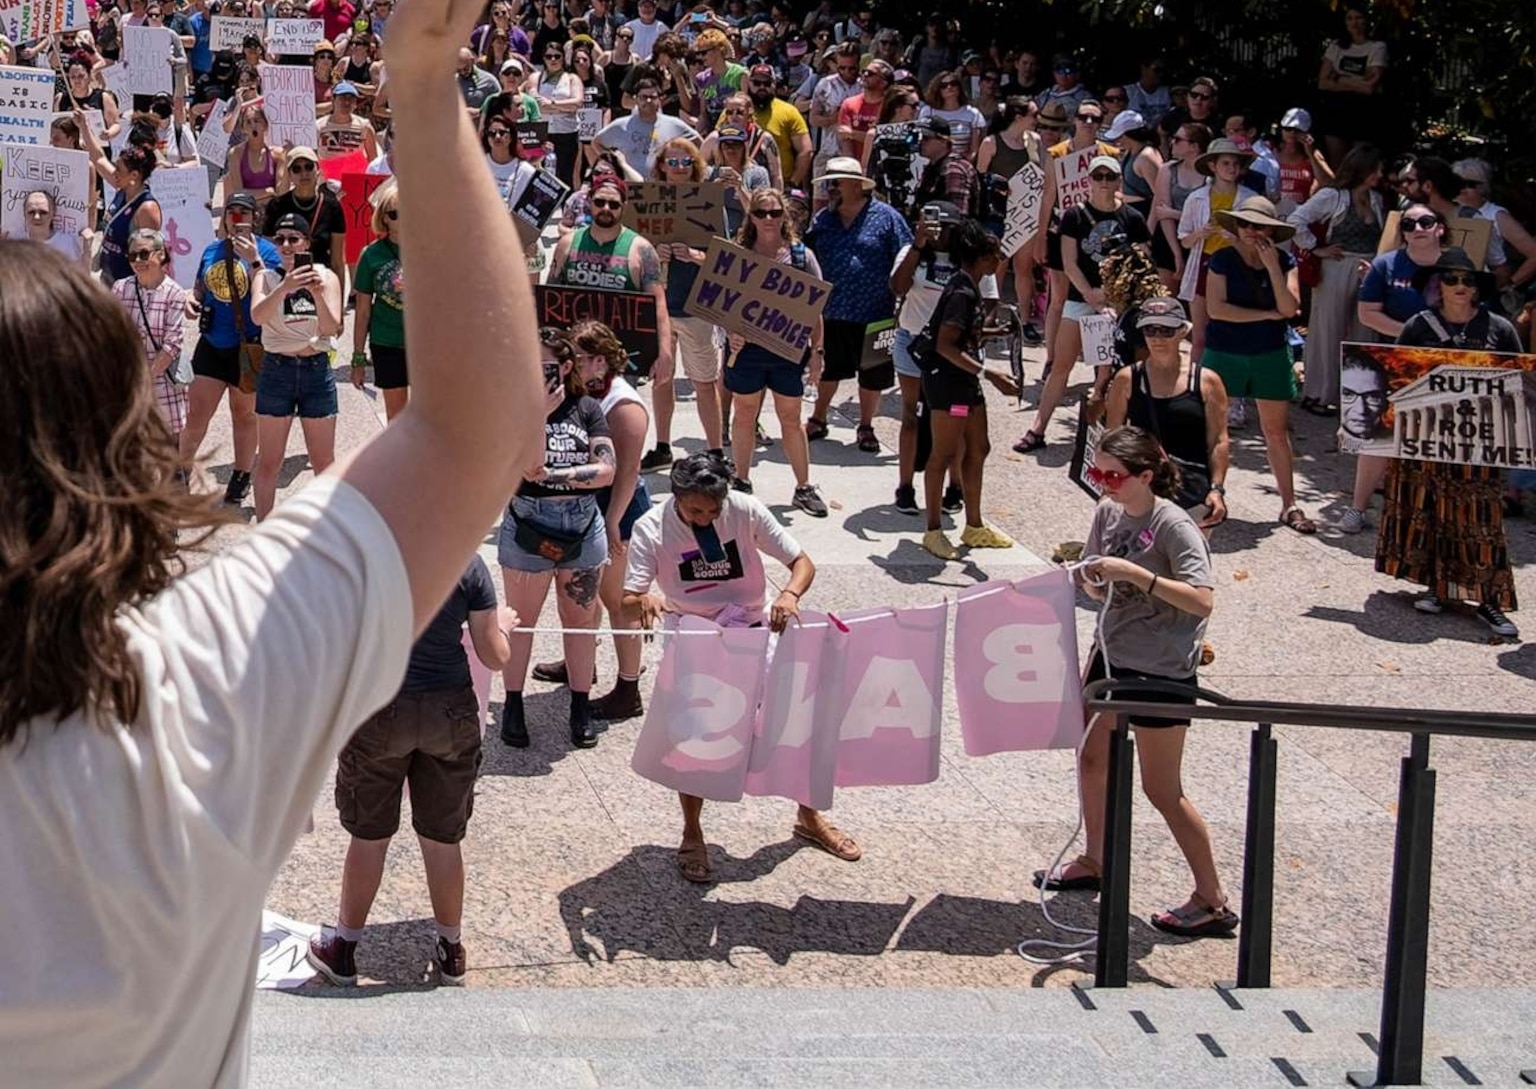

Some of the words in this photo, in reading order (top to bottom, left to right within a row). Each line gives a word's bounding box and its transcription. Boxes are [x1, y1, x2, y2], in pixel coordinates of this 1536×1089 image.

[9, 17, 19, 42] GAY
[20, 5, 31, 42] TRANS
[264, 65, 313, 93] ABORTION
[12, 87, 29, 97] IS
[266, 94, 312, 124] SAVES
[6, 147, 71, 183] KEEP
[628, 184, 676, 201] I'M
[1060, 179, 1089, 194] THE
[4, 188, 27, 211] yo
[53, 185, 88, 212] laws
[633, 202, 676, 214] WITH
[1018, 193, 1037, 210] IS
[1062, 191, 1090, 209] BOS
[636, 217, 674, 235] HER
[566, 269, 627, 290] BODIES
[713, 248, 754, 284] MY
[758, 267, 826, 307] BODY
[544, 289, 657, 333] REGULATE
[695, 278, 741, 311] MY
[740, 300, 813, 350] CHOICE
[1430, 374, 1505, 396] RUTH
[1456, 399, 1477, 417] &
[553, 423, 589, 445] BODIES
[1439, 419, 1495, 441] ROE
[548, 437, 576, 451] OUR
[1403, 438, 1475, 464] SENT
[1482, 445, 1533, 468] ME!
[545, 450, 589, 464] TURES
[694, 569, 729, 579] BODIES
[710, 562, 731, 570] OUR
